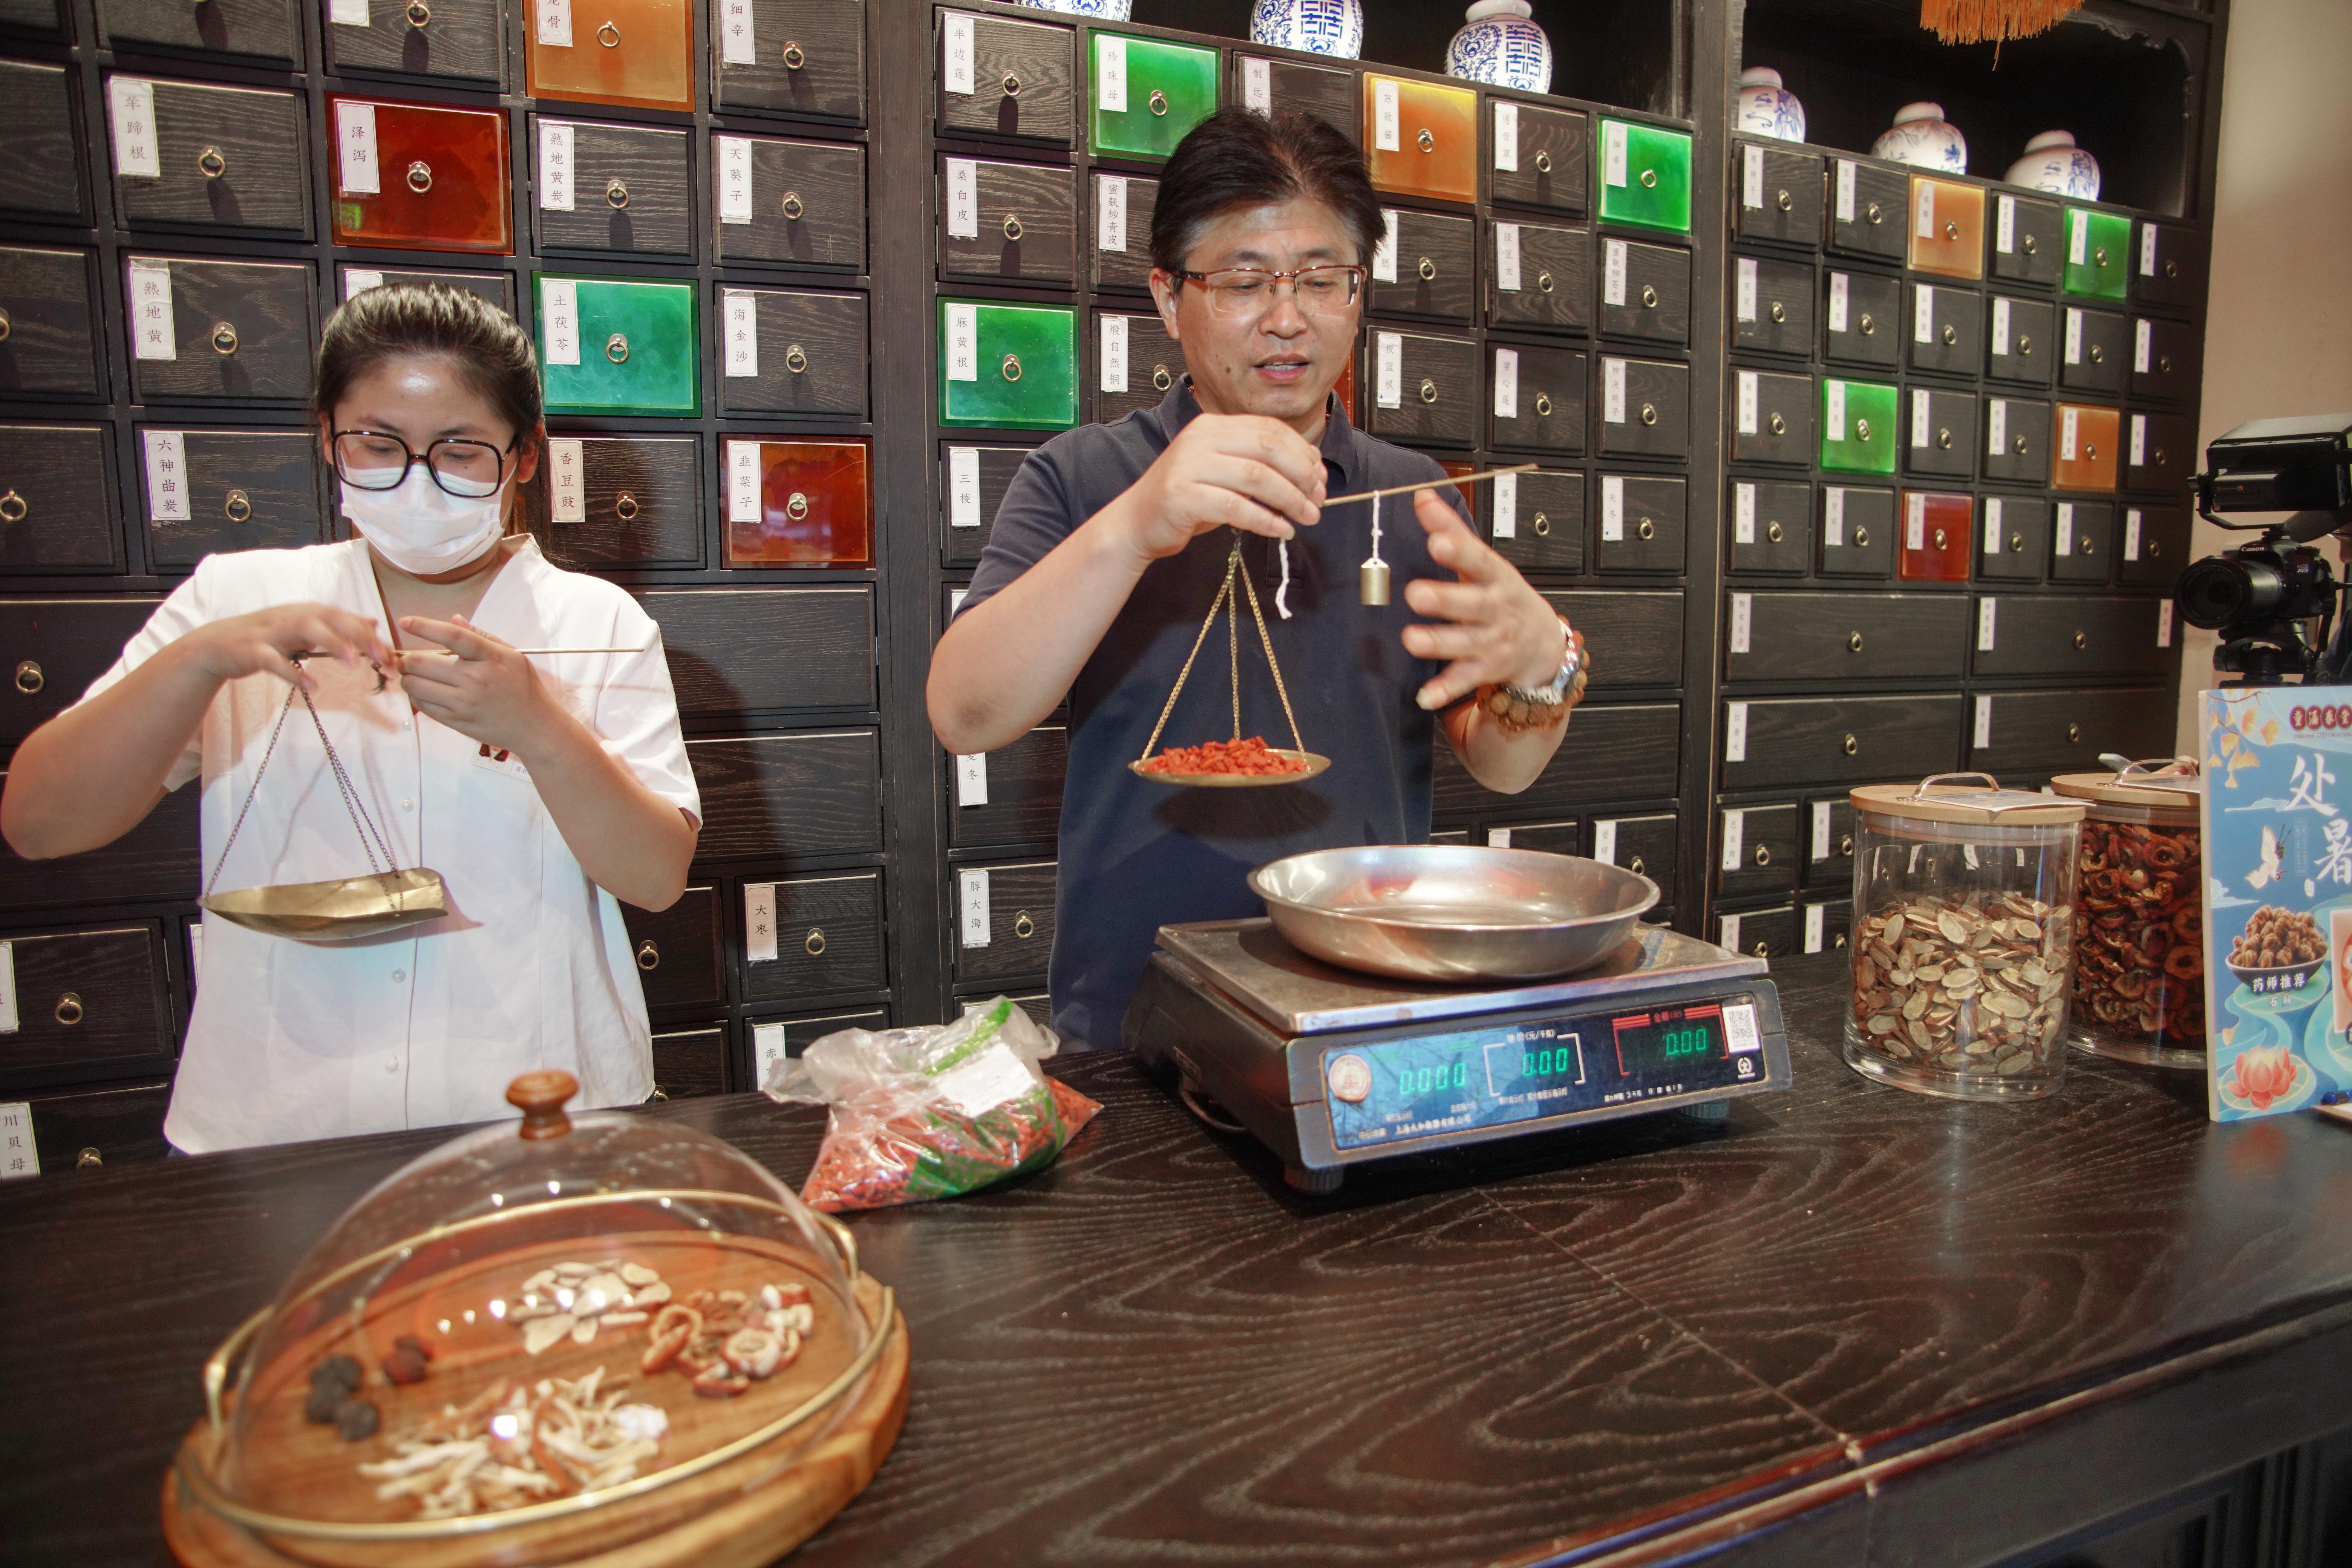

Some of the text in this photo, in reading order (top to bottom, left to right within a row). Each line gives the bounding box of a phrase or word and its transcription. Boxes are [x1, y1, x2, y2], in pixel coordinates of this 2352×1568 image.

[730, 3, 744, 37] 细辛
[954, 28, 965, 80] 半边莲
[1107, 51, 1118, 101] 珍珠母
[124, 95, 147, 160] 羊蹄根
[1383, 93, 1393, 140] 苏败酱
[1502, 113, 1511, 159] 透骨草
[351, 126, 366, 162] 泽泻
[550, 132, 564, 203] 熟地黄炭
[1612, 139, 1621, 165] 细辛
[729, 149, 743, 202] 天葵子
[956, 170, 968, 220] 桑白皮
[1107, 184, 1119, 245] 蜜麸炒青皮
[1504, 232, 1514, 276] 绿豆衣
[144, 281, 163, 344] 熟地黄
[553, 295, 569, 351] 土茯苓
[734, 308, 748, 363] 海金沙
[956, 316, 968, 368] 麻黄根
[1109, 325, 1120, 385] 煅自然铜
[1385, 343, 1394, 389] 板蓝根
[1501, 361, 1511, 406] 穿心莲
[1611, 366, 1620, 416] 炒决明子
[158, 439, 178, 512] 六神曲炭
[559, 452, 576, 508] 香豆豉
[738, 455, 752, 508] 韭菜子
[959, 474, 971, 504] 三棱
[1608, 494, 1617, 519] 天冬
[2285, 753, 2352, 884] 处暑
[755, 904, 768, 935] 大枣
[970, 880, 982, 928] 胖大海
[2252, 972, 2305, 992] 药师推荐
[2268, 994, 2292, 1008] 石斛
[1522, 1048, 1568, 1077] 0.00
[1666, 1029, 1707, 1056] 0.00
[1400, 1062, 1466, 1095] 0.000
[3, 1114, 26, 1171] 川贝母
